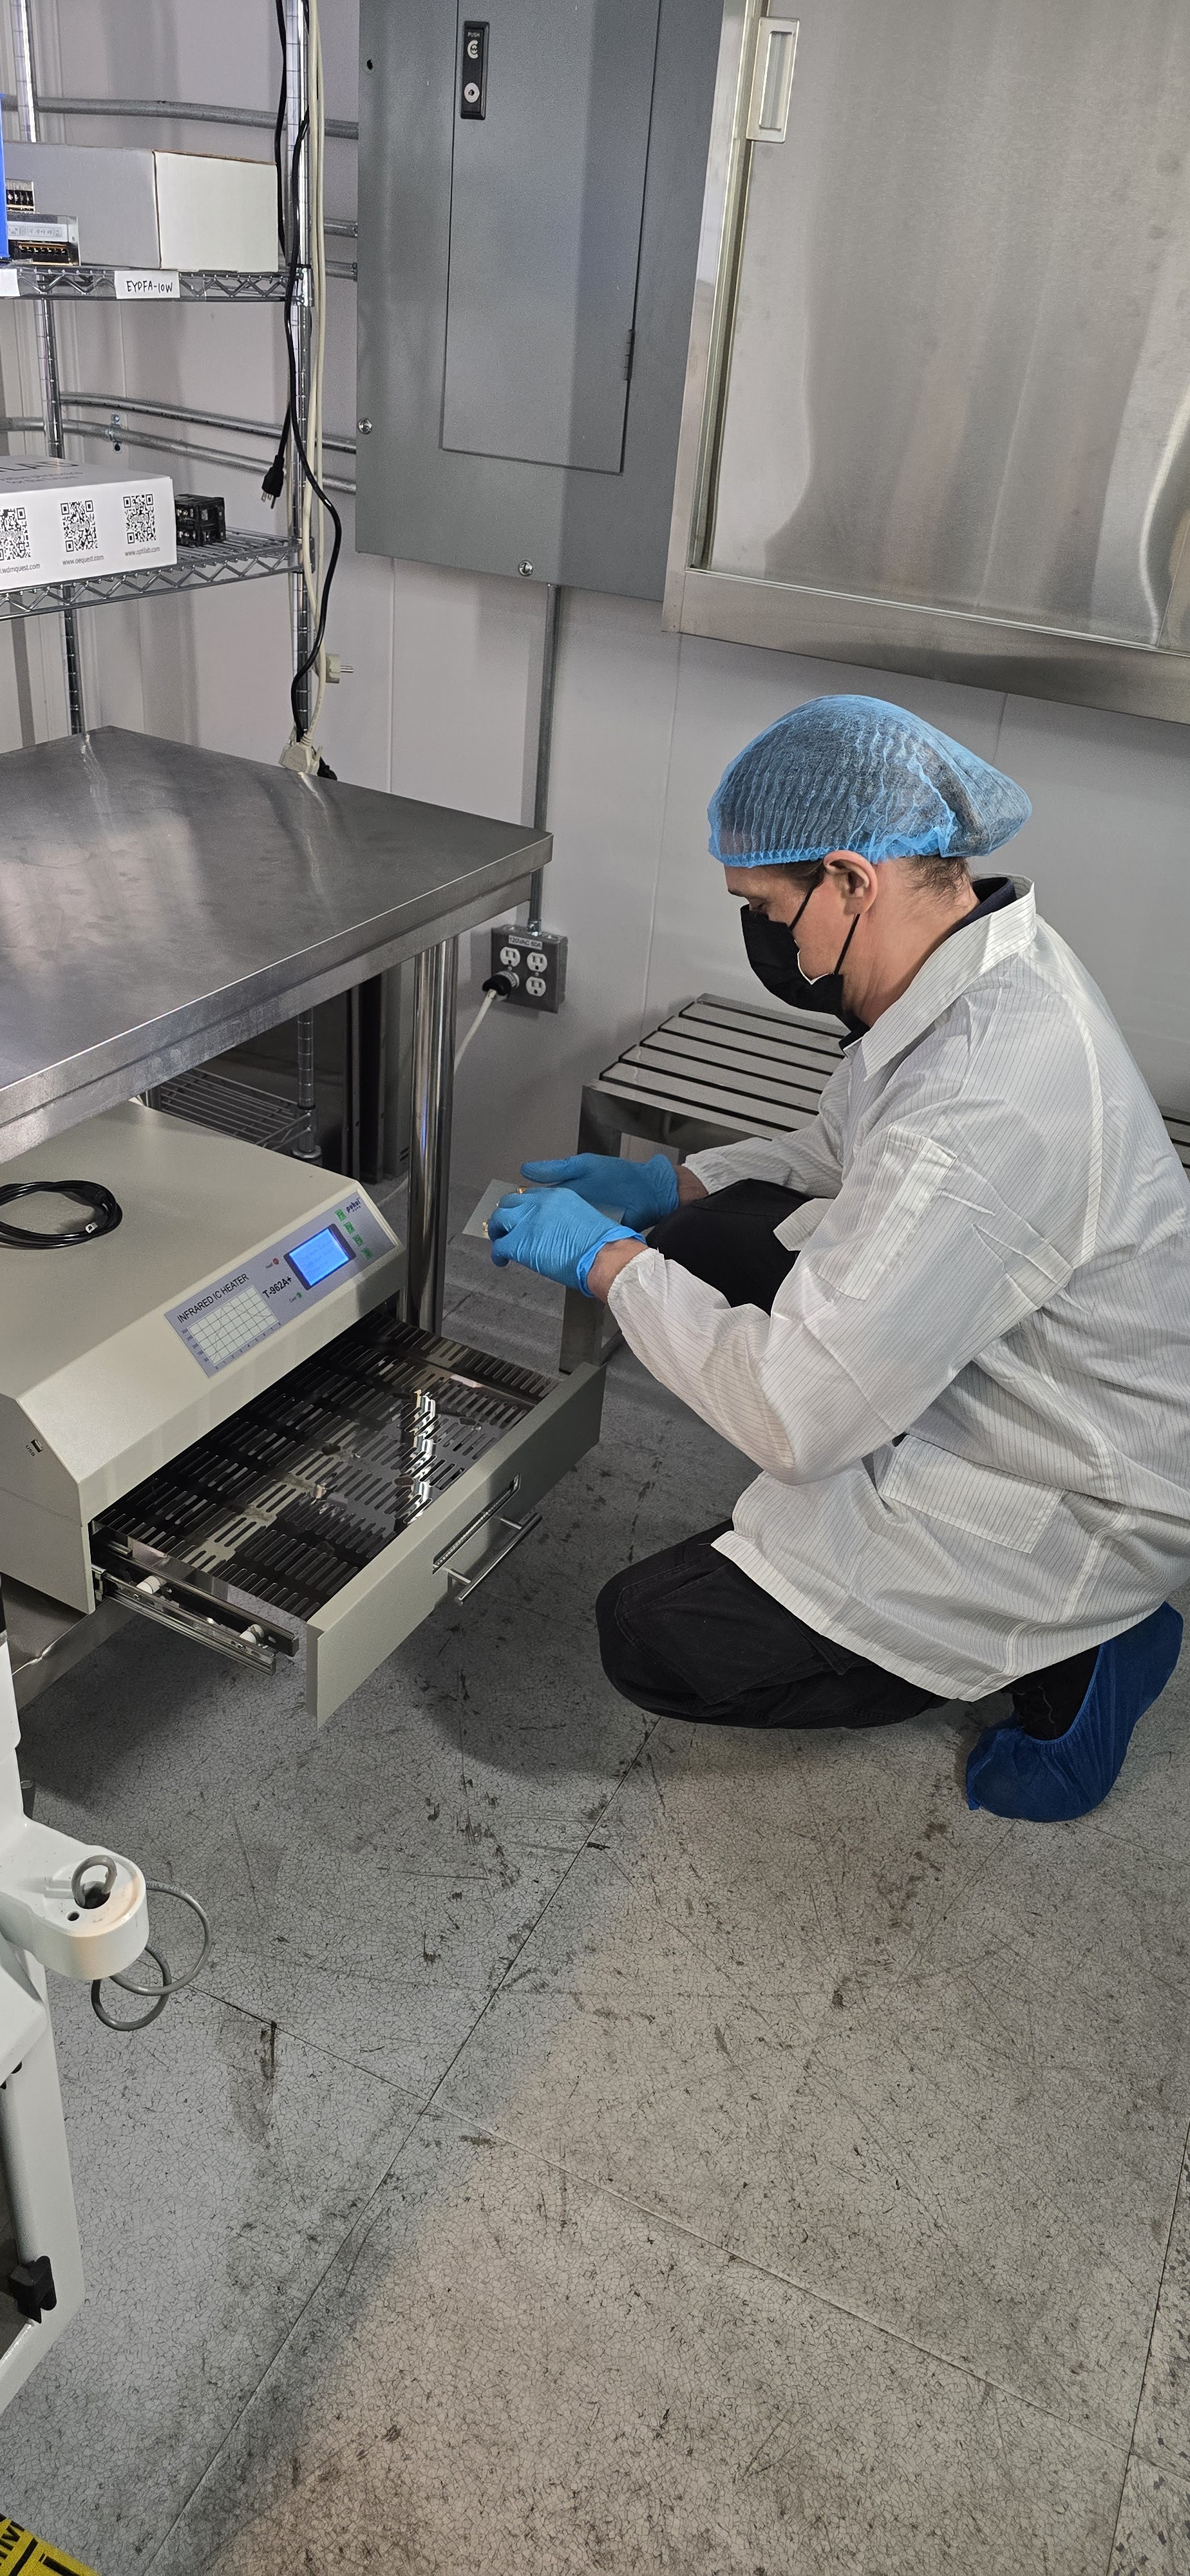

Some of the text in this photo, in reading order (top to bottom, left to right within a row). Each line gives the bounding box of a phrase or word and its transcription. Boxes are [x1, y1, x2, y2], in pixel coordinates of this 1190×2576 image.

[126, 280, 173, 293] EYDFA-10W
[125, 546, 160, 556] www.optilab.com
[62, 555, 104, 565] www.oequest.com
[262, 1276, 292, 1298] T-962A+
[177, 1273, 250, 1323] INFRARED IC HEATER
